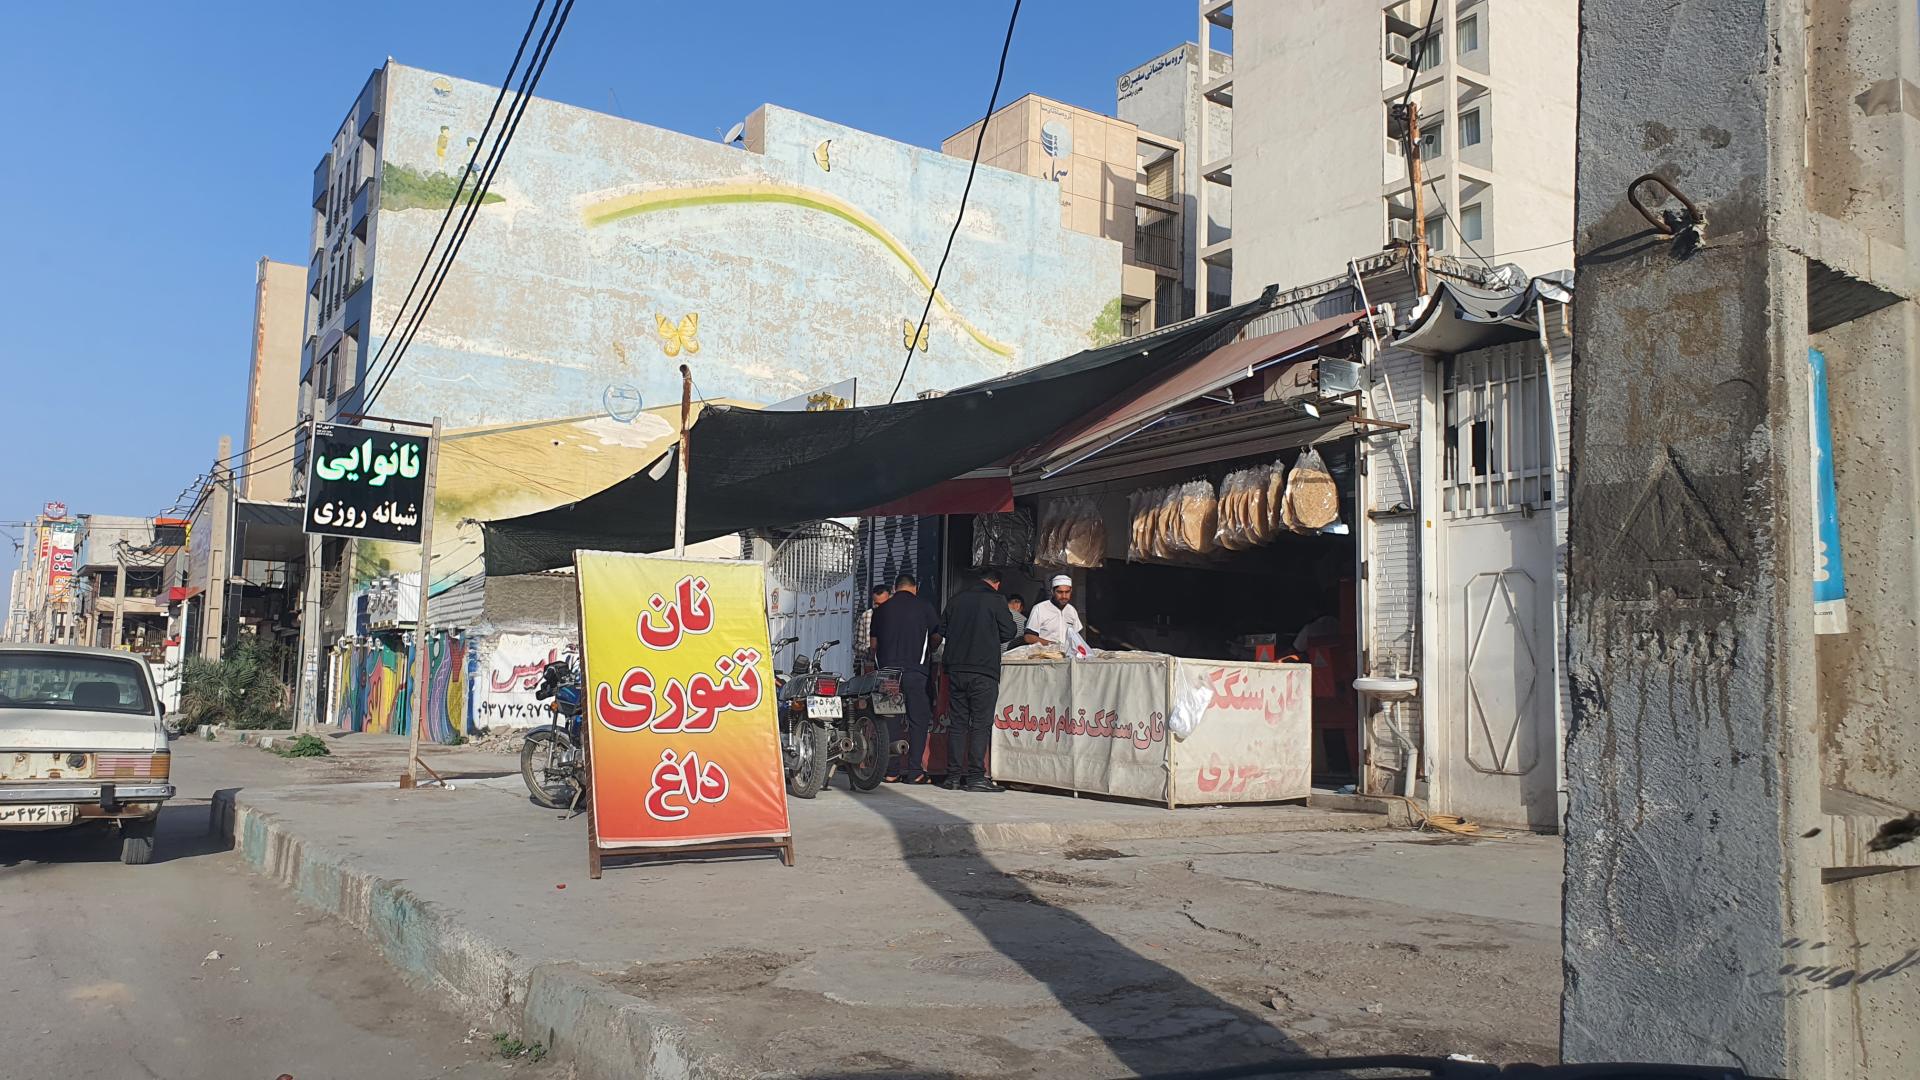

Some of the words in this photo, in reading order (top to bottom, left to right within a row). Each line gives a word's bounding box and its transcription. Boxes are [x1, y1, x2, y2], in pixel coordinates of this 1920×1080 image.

[316, 438, 420, 487] نانوایی
[313, 500, 367, 529] روزی
[372, 501, 418, 531] شبانه
[638, 576, 713, 649] نان
[597, 649, 761, 732] تنوری
[994, 704, 1056, 741] اتوماتیک
[1056, 707, 1086, 742] تمام
[1086, 708, 1133, 740] سنگک
[1133, 711, 1165, 750] نان
[646, 750, 728, 819] داغ
[51, 809, 69, 822] ۱۴
